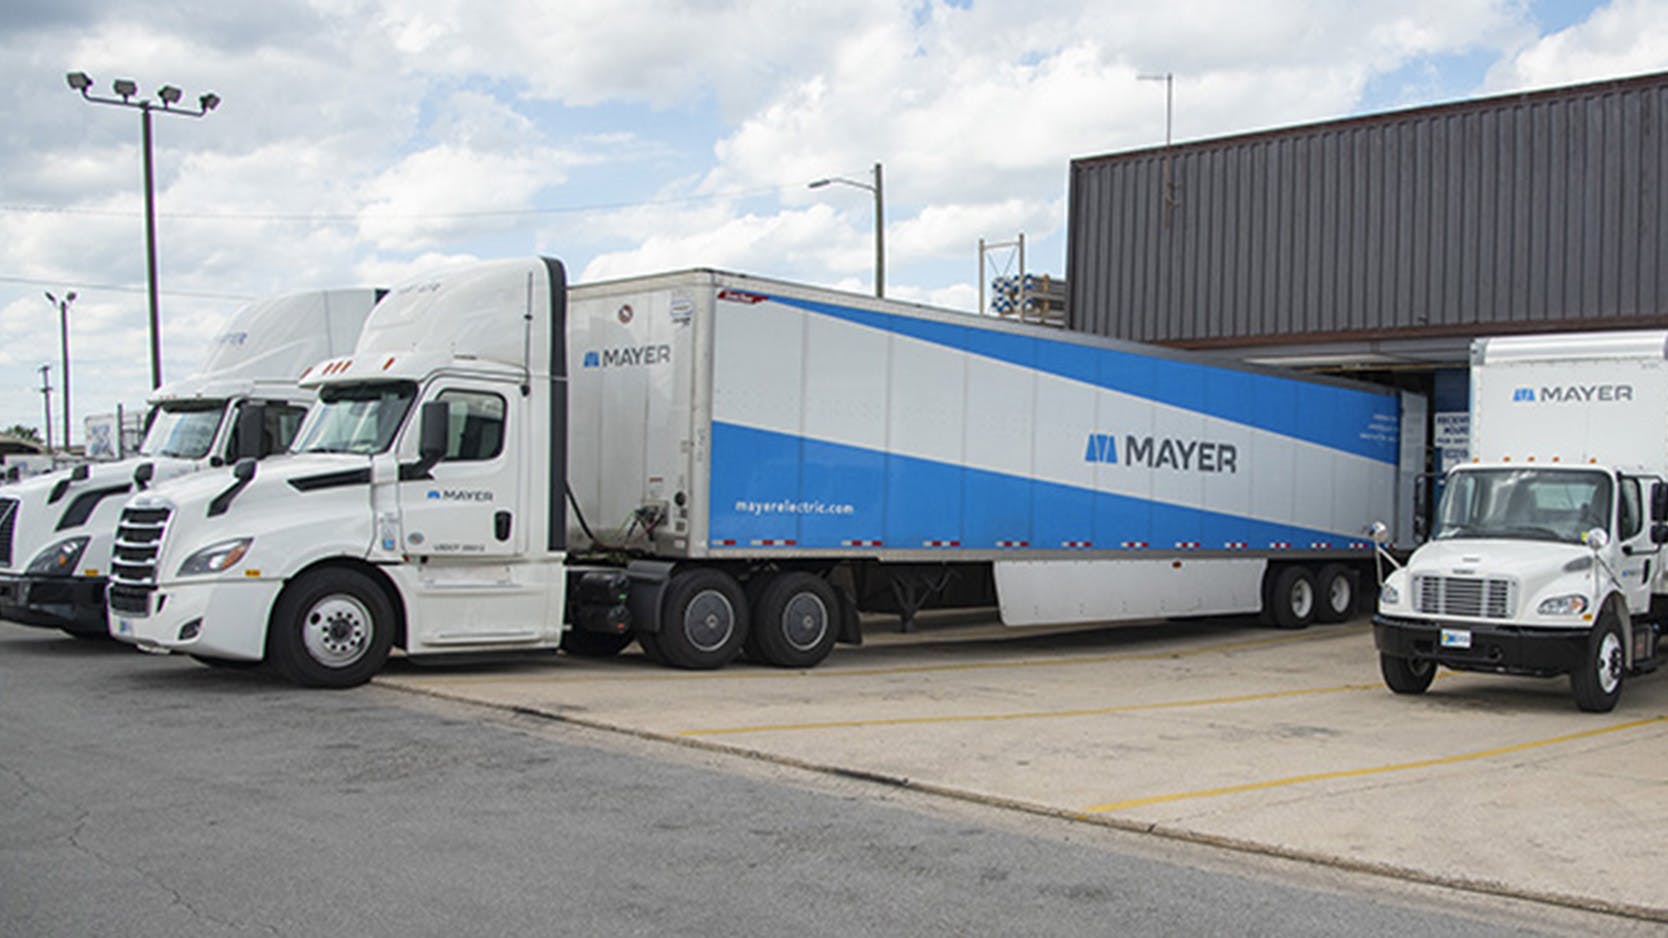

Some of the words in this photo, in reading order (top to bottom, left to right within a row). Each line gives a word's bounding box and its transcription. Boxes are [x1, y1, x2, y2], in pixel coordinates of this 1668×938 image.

[603, 344, 671, 367] MAYER
[1540, 385, 1633, 402] MAYER
[1125, 434, 1237, 474] MAYER
[443, 490, 493, 501] MAYER
[735, 499, 854, 515] mayerelectric.com
